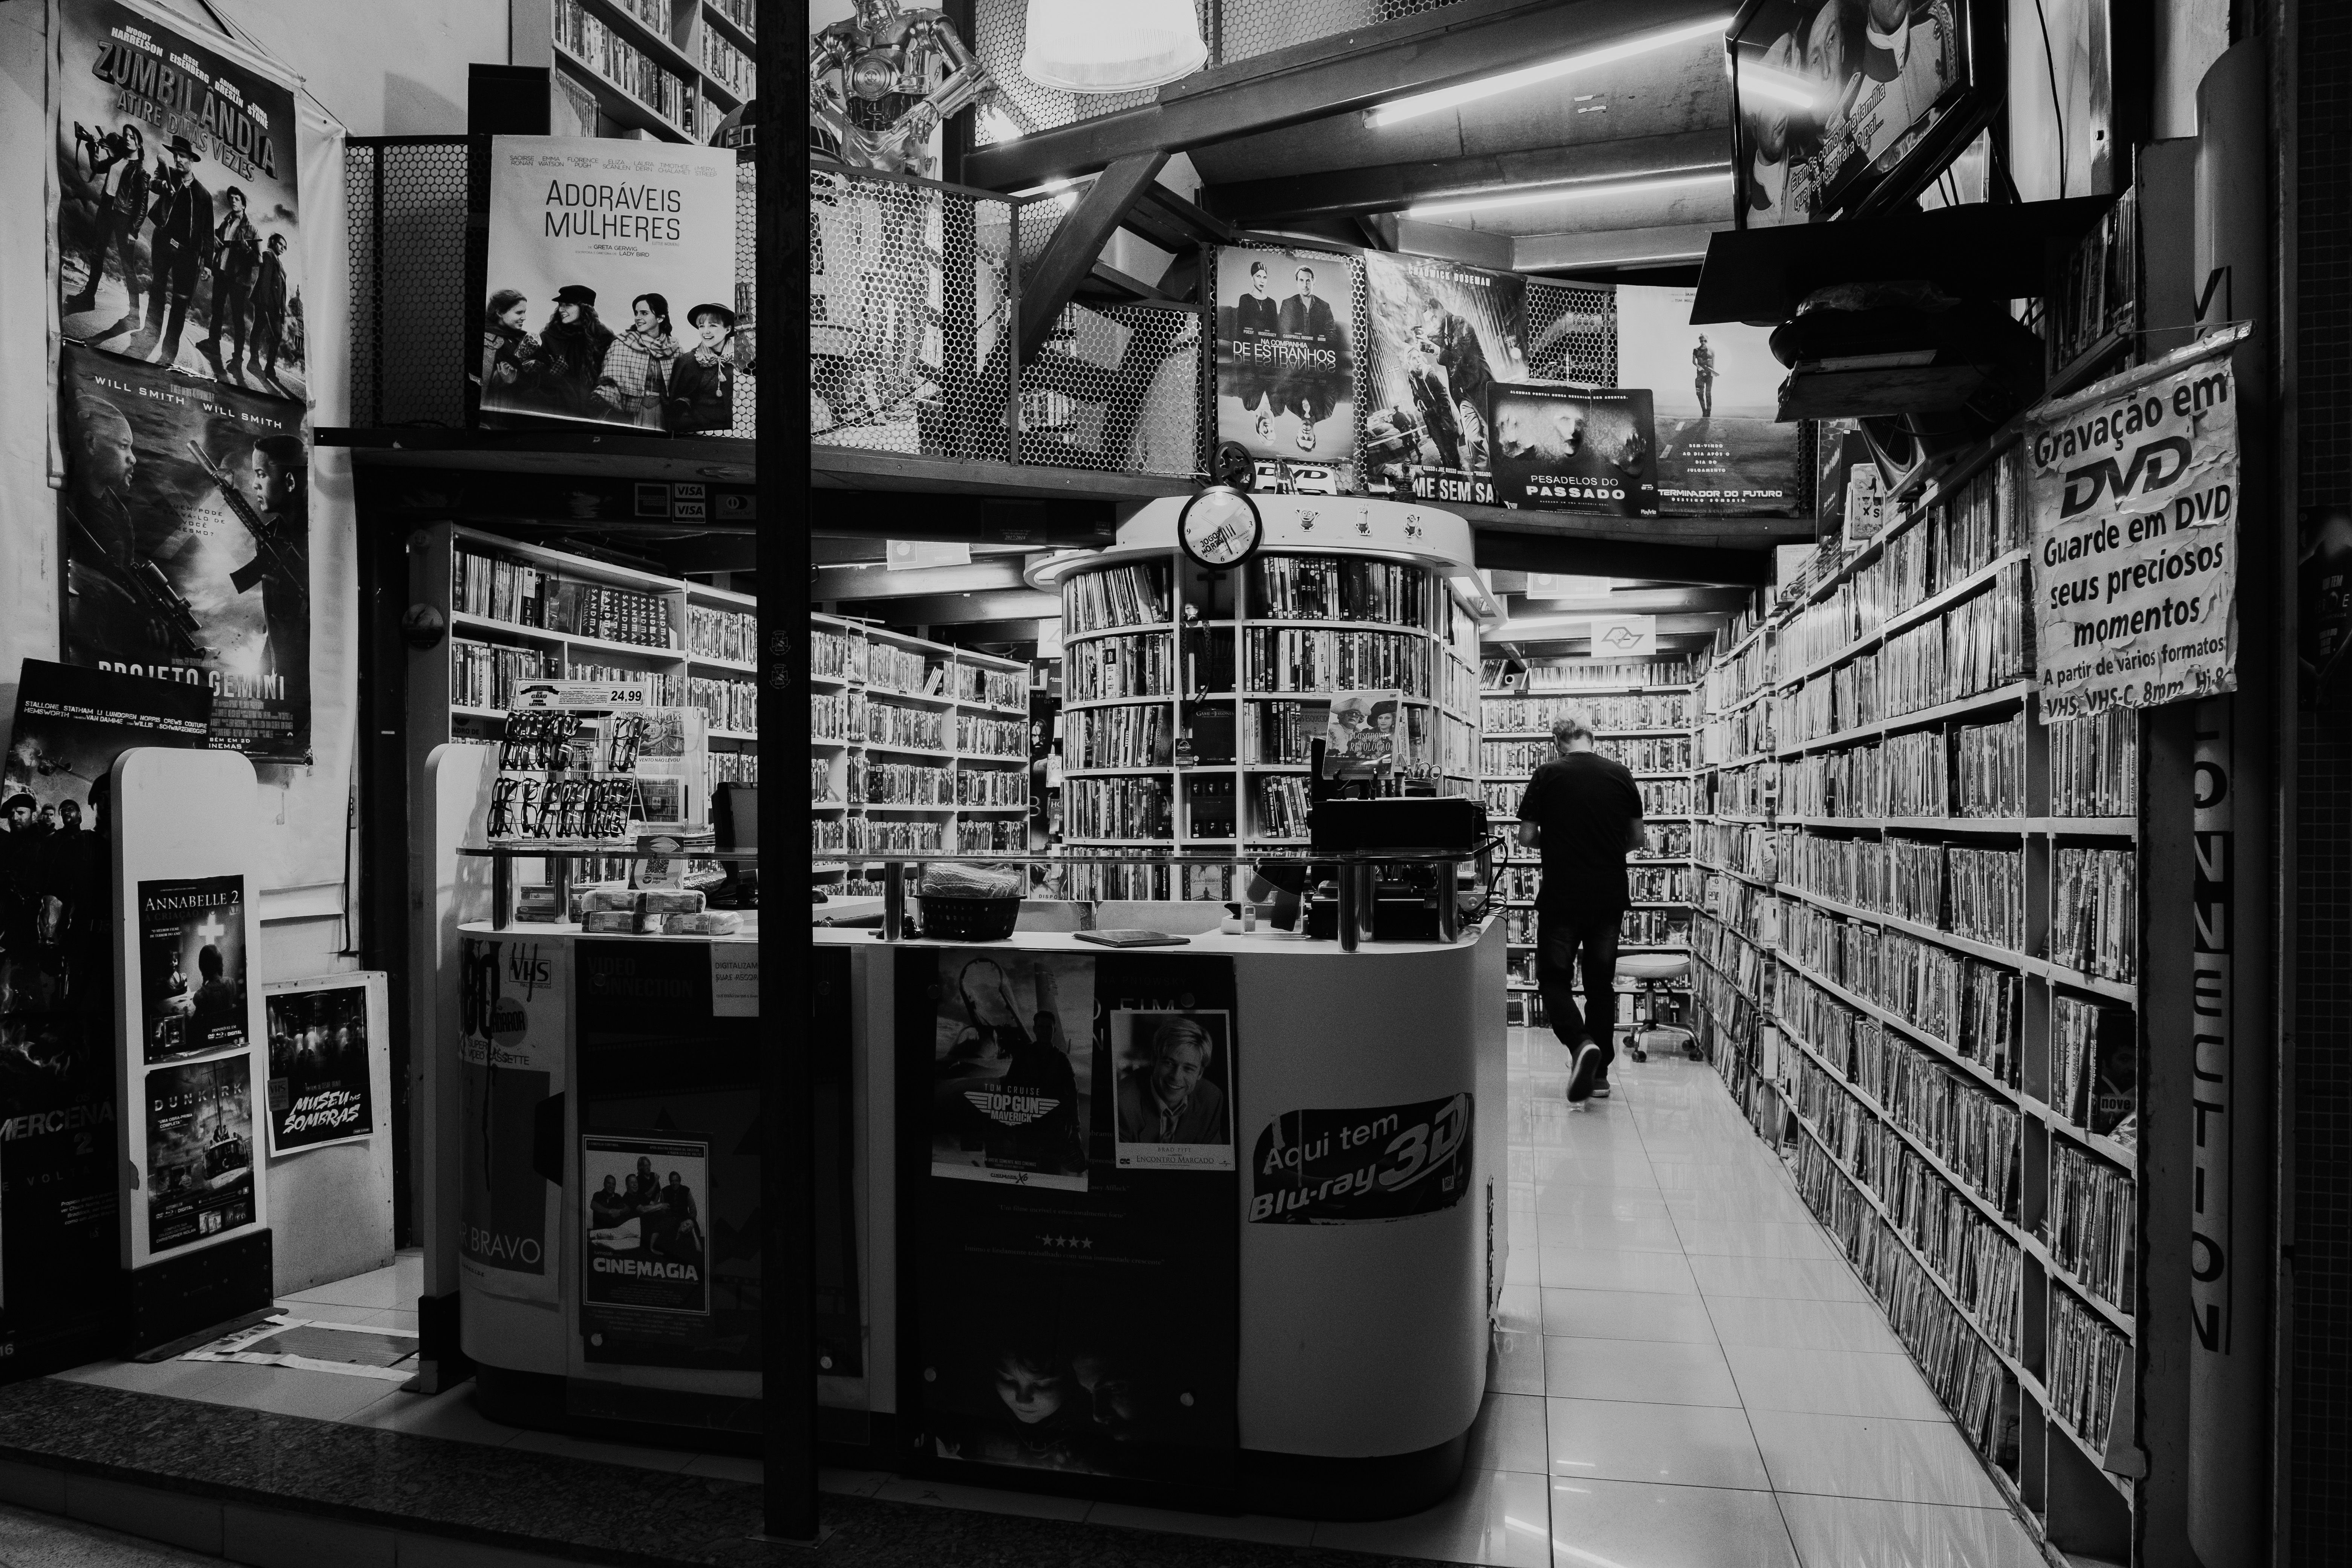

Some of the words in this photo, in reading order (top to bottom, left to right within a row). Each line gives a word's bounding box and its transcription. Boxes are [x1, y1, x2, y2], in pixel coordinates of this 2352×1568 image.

[111, 27, 163, 57] HARRELSON
[126, 25, 152, 41] WOODY
[170, 52, 210, 84] EISENBERG
[182, 53, 199, 68] JESSE
[214, 81, 243, 108] BRESLIN
[219, 78, 240, 97] ABIGAIL
[92, 40, 278, 180] ZUMBILÂNDIA
[248, 105, 268, 129] STONE
[251, 103, 268, 119] EMMA
[117, 91, 161, 127] ATIRE
[167, 113, 208, 152] DUAS
[206, 138, 255, 182] VEZES
[1791, 158, 1817, 191] Éramos
[1818, 135, 1838, 162] como
[1839, 118, 1856, 142] uma
[1857, 85, 1885, 121] família
[1794, 189, 1808, 211] que
[1809, 145, 1854, 191] reencontrara
[1857, 136, 1862, 146] o
[545, 179, 681, 213] ADORÁVEIS
[545, 209, 680, 242] MULHERES
[1408, 263, 1450, 280] CHADWICK
[1454, 273, 1490, 286] BOSEMAN
[1233, 341, 1251, 355] DE
[1254, 343, 1336, 363] ESTRANHOS
[1271, 340, 1308, 349] COMPANHIA
[95, 376, 132, 392] WILL
[139, 387, 185, 405] SMITH
[203, 403, 235, 418] WILL
[241, 413, 282, 429] SMITH
[2034, 392, 2163, 468] Gravação
[2172, 372, 2228, 417] em
[1531, 475, 1597, 485] PESADELOS
[1602, 478, 1618, 486] DO
[2060, 435, 2195, 519] DVD
[678, 487, 703, 496] VISA
[1439, 479, 1471, 502] SEM
[1526, 485, 1625, 499] PASSADO
[678, 505, 703, 515] VISA
[2043, 518, 2121, 568] Guarde
[2127, 507, 2167, 544] em
[2174, 483, 2231, 532] DVD
[2050, 574, 2099, 609] seus
[2106, 541, 2224, 605] preciosos
[2073, 595, 2200, 648] momentos
[2043, 668, 2054, 686] A
[2056, 654, 2092, 689] partir
[2095, 656, 2114, 676] de
[2116, 648, 2157, 672] vários
[209, 671, 284, 700] GEMINI
[611, 690, 642, 703] 24,99
[24, 707, 69, 718] HEMSWORTH
[100, 716, 123, 724] DAMME
[159, 723, 207, 735] SCHWARZENEGGER
[25, 700, 60, 710] STALLONE
[63, 705, 93, 715] STATHAM
[106, 710, 136, 720] LUNDGREN
[185, 721, 207, 729] COUTURE
[1353, 731, 1387, 740] Casanova
[145, 893, 227, 911] ANNABELLE
[231, 890, 239, 903] 2
[510, 960, 549, 982] VHS
[155, 1082, 242, 1111] DUNKIRK
[985, 1083, 1001, 1092] TOM
[1008, 1086, 1040, 1096] CRUISE
[289, 1091, 350, 1116] MUSEU
[987, 1093, 1011, 1111] TOP
[1012, 1096, 1038, 1113] GUN
[2102, 1098, 2131, 1110] nove
[283, 1104, 361, 1134] SOMBRAS
[991, 1110, 1032, 1123] MAVERICK
[74, 1132, 94, 1155] 2
[1263, 1132, 1329, 1174] Aqui
[1339, 1113, 1398, 1150] tem
[1248, 1164, 1377, 1223] Blu-ray
[1378, 1093, 1467, 1186] 3D
[472, 1227, 541, 1263] BRAVO
[992, 1246, 1027, 1256] lindamente
[1028, 1250, 1061, 1259] trabalhado
[1093, 1254, 1130, 1263] intensidade
[593, 1257, 699, 1281] CINEMAGIA
